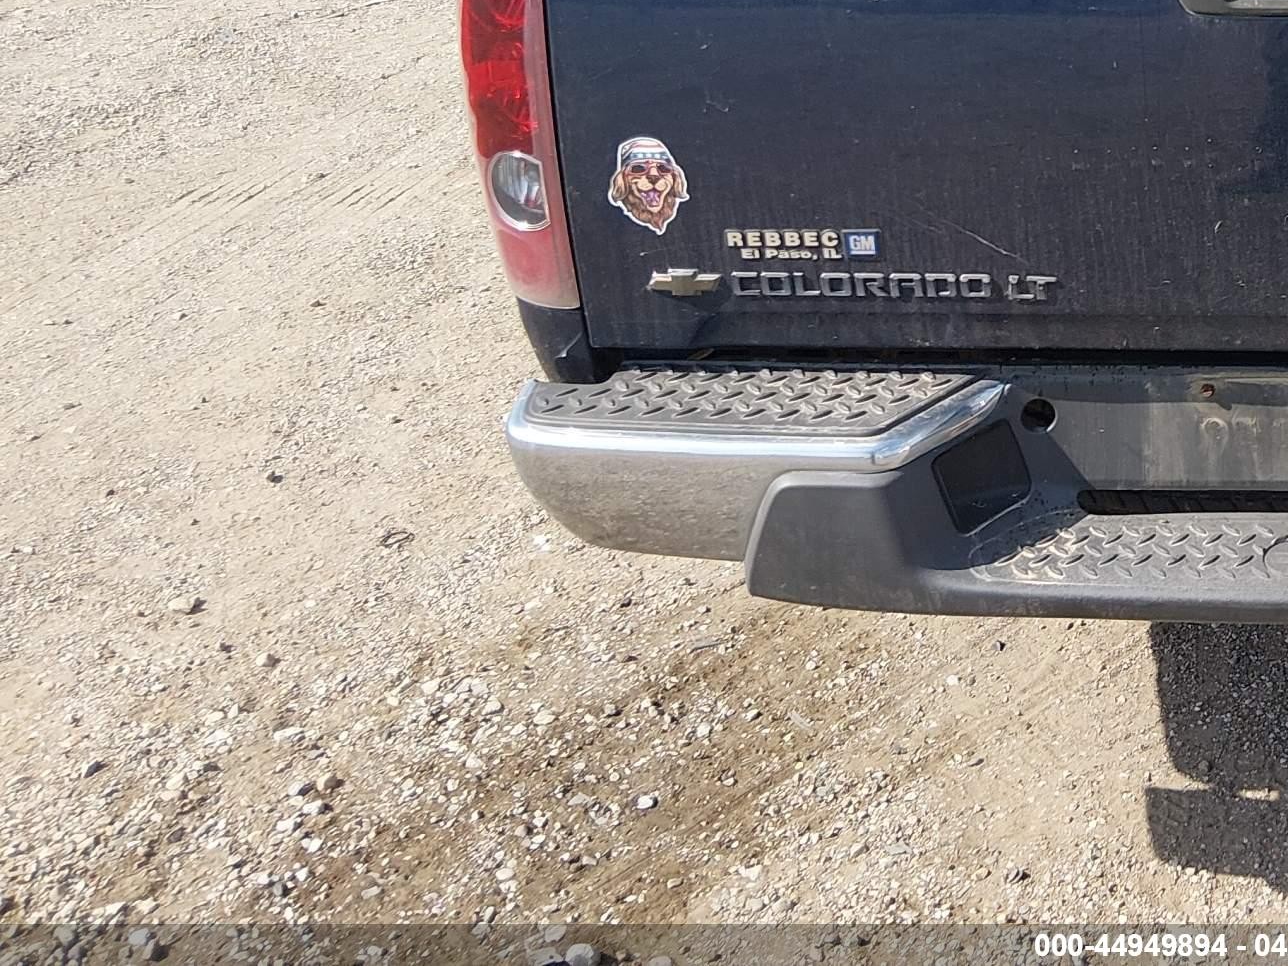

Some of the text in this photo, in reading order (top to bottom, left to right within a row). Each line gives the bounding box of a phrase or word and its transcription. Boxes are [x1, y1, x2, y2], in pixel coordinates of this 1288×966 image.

[725, 229, 840, 247] REBBEC
[850, 235, 876, 251] GM
[764, 248, 818, 260] Paso,
[823, 247, 843, 259] IL
[730, 271, 1058, 300] COLORADO LT
